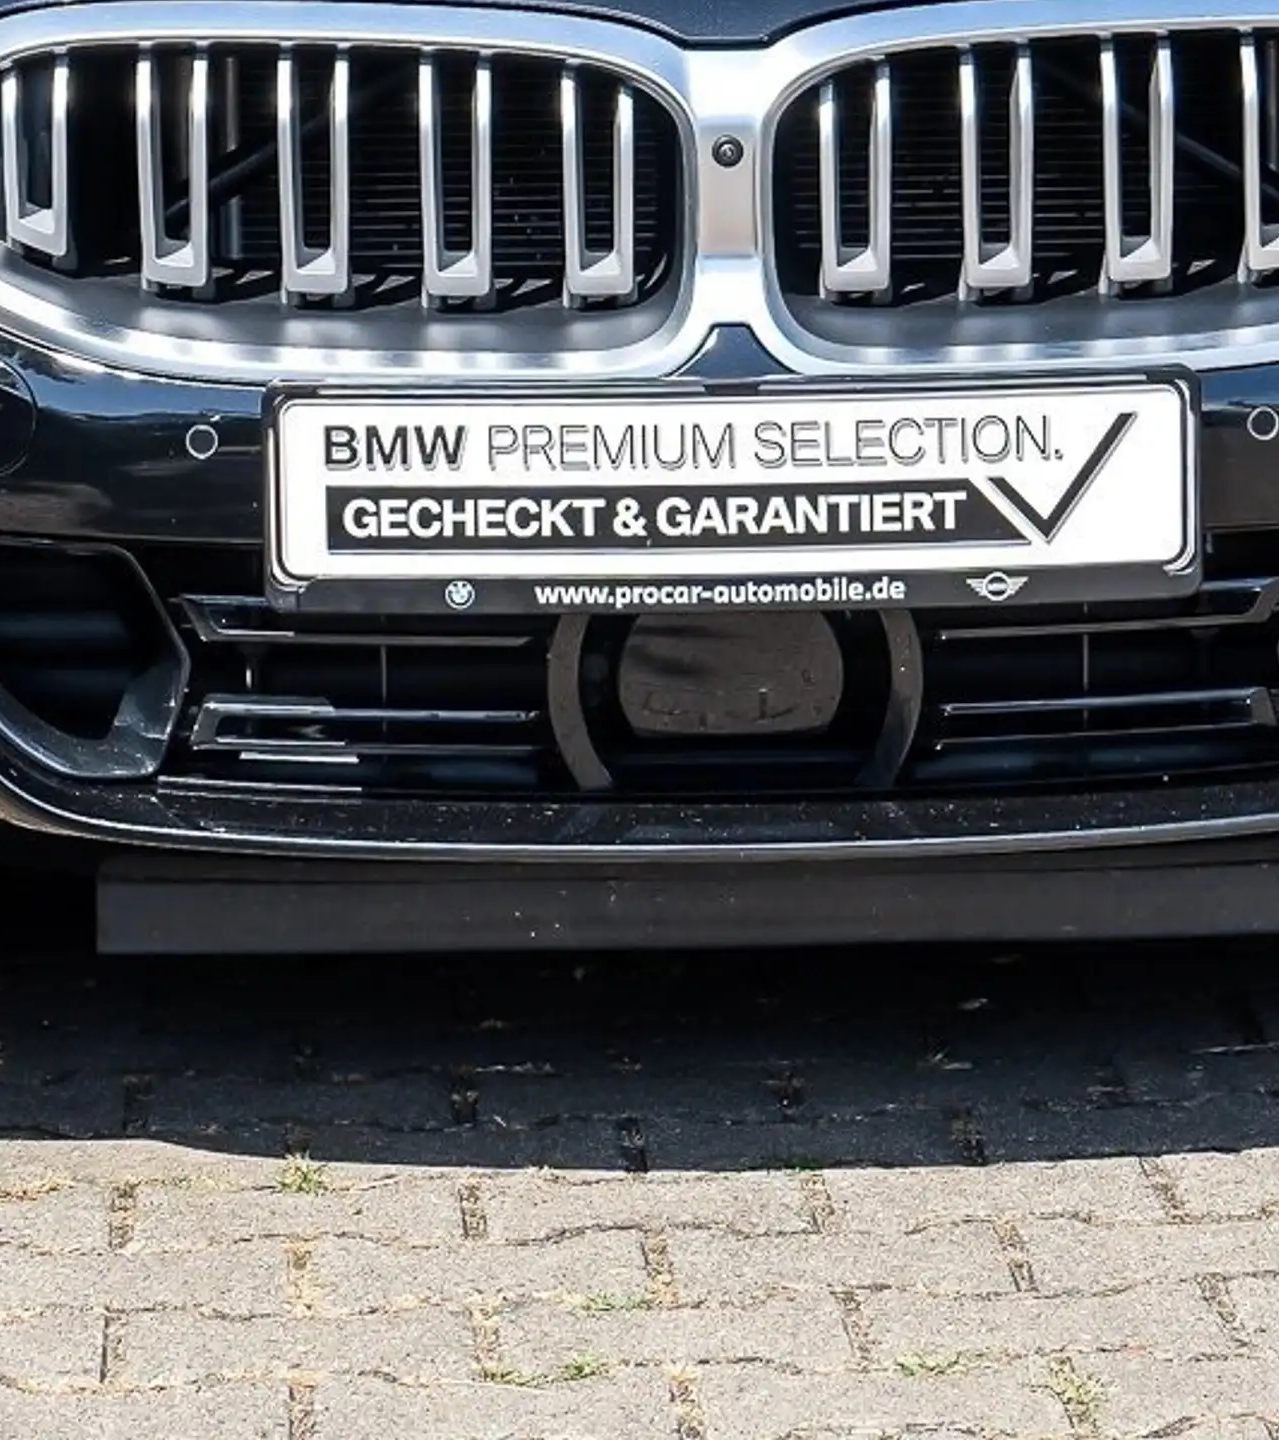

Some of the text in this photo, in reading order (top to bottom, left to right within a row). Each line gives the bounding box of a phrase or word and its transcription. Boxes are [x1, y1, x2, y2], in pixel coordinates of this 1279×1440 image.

[323, 414, 1064, 471] BMW PREMIUM SELECTION.
[342, 490, 968, 539] GECHECKT & GARANTIERT
[533, 576, 906, 609] www.procar-automobile.de
